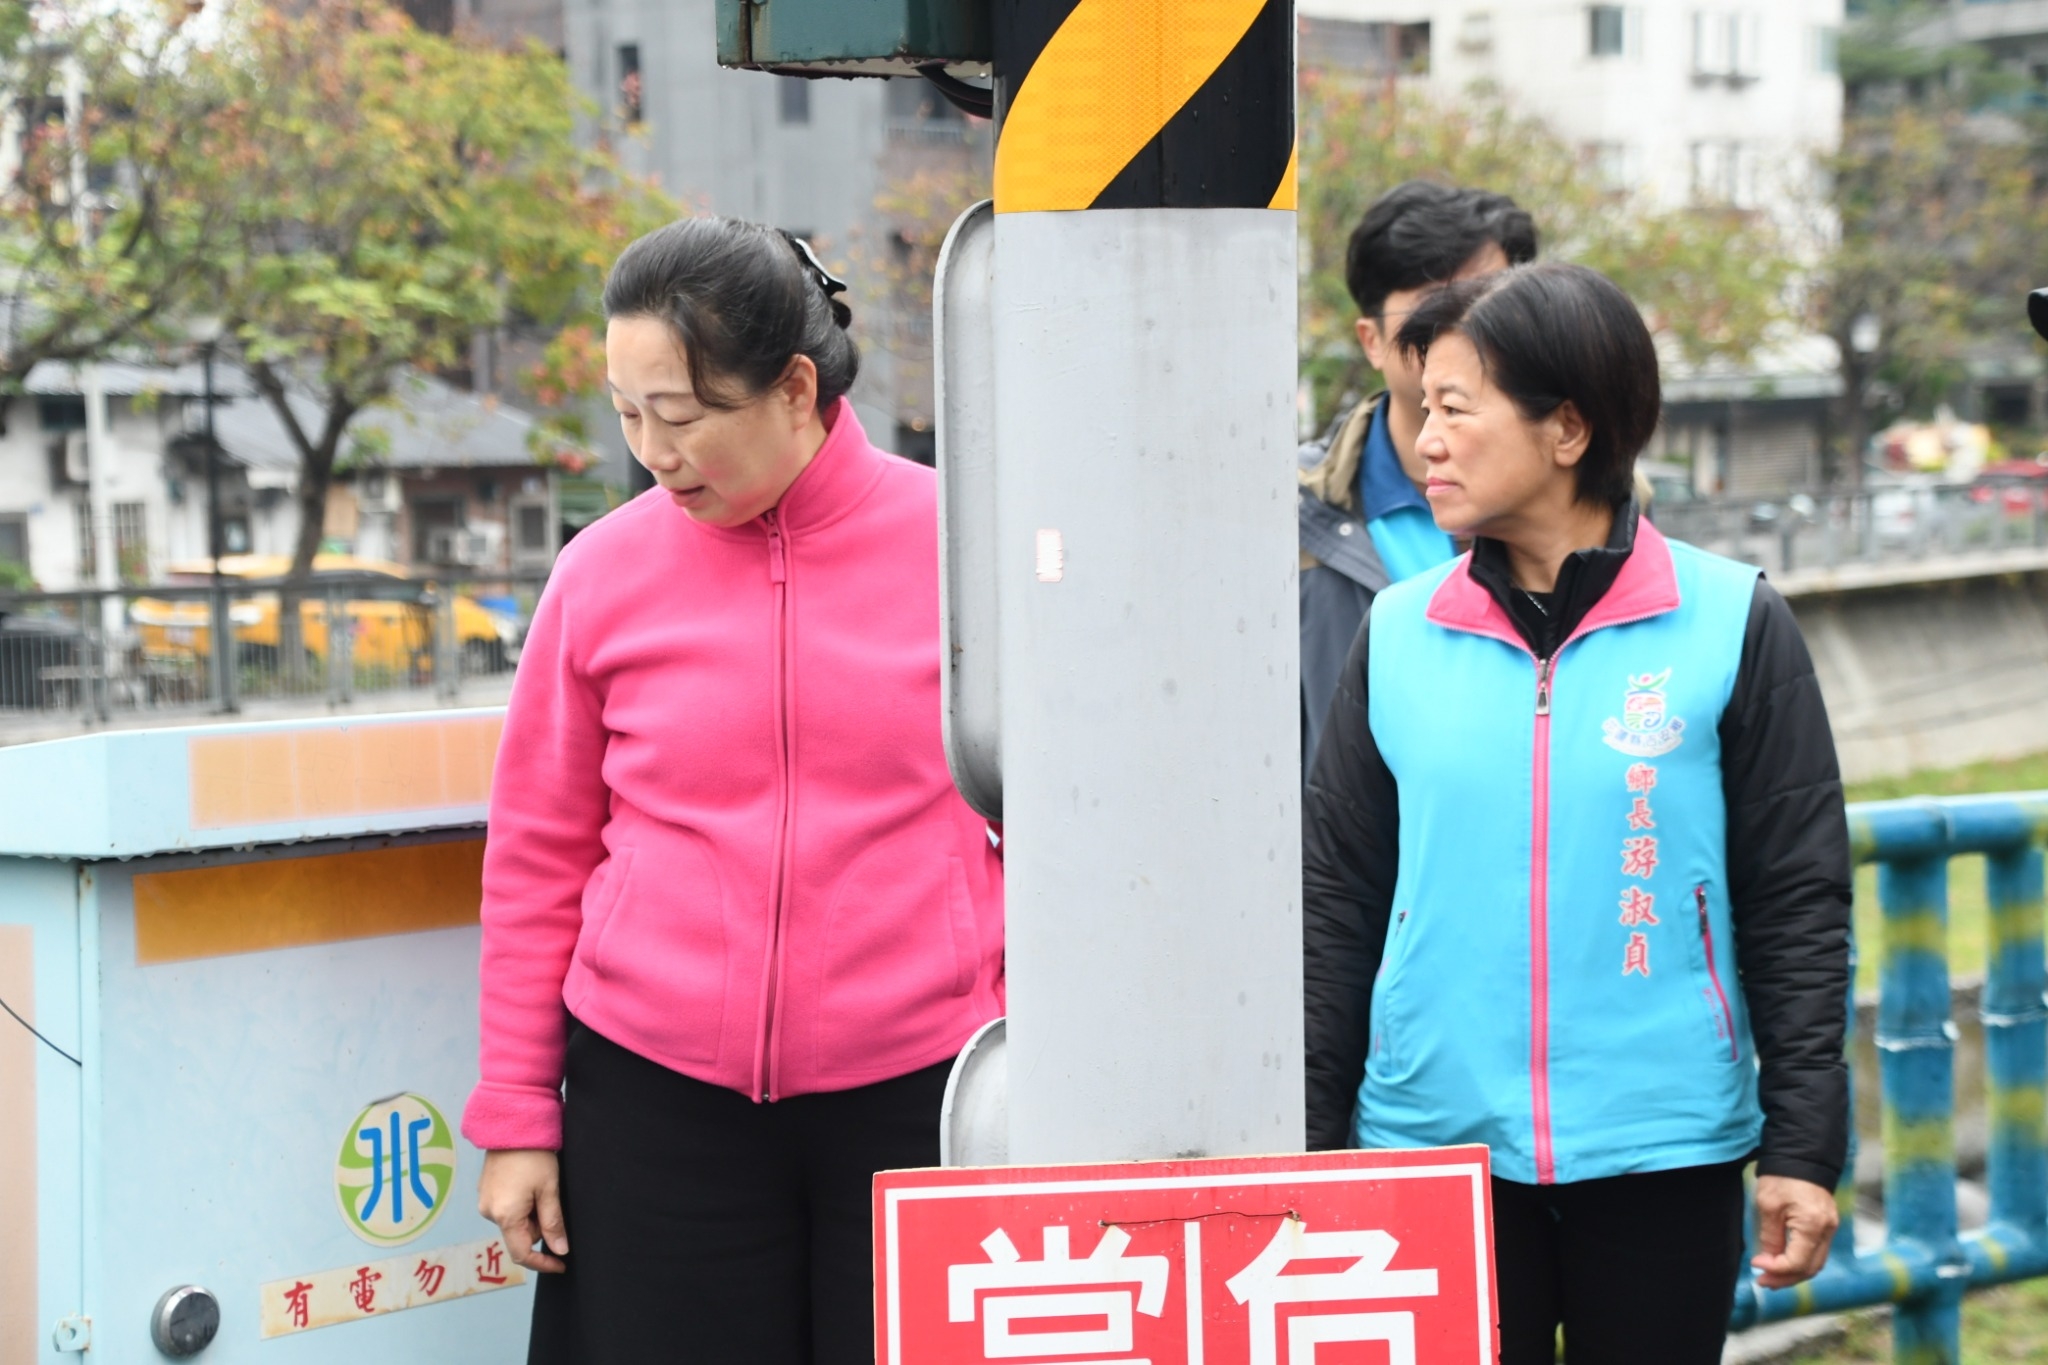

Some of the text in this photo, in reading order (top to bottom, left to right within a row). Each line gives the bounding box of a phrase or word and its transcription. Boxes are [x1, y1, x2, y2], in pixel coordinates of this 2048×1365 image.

[1620, 762, 1659, 976] 鄉長游淑貞
[284, 1242, 507, 1328] 有電勿近
